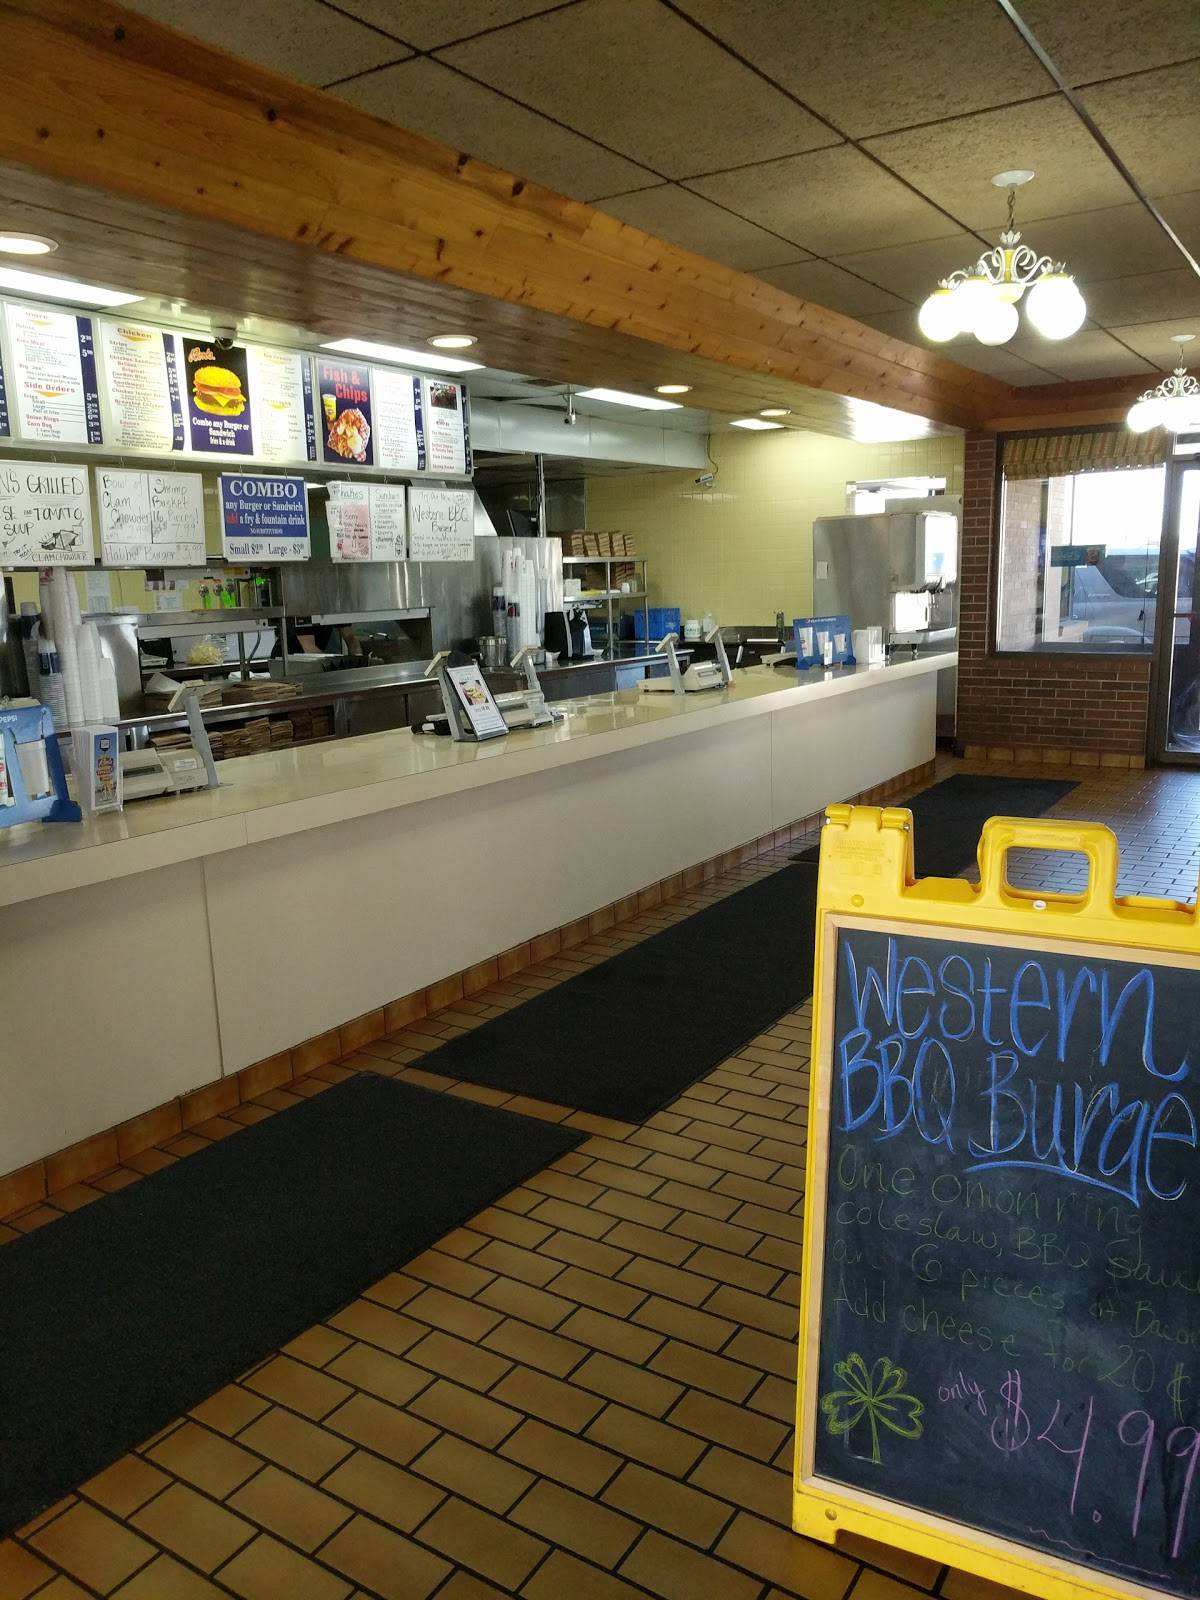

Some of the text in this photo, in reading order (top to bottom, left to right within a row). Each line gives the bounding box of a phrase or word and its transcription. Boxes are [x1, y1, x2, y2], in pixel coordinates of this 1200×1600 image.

[117, 328, 152, 339] Chicken
[322, 367, 361, 386] Fish &
[24, 381, 76, 393] Side Orders
[335, 384, 368, 404] Chips
[192, 416, 213, 426] Combo
[223, 420, 242, 431] Burger
[209, 427, 236, 438] Sandwich
[26, 473, 85, 496] GRILLED
[229, 480, 298, 499] COMBO
[33, 507, 83, 521] TOMATO
[225, 500, 304, 512] any Burger or Sandwich
[244, 513, 254, 526] fry
[261, 513, 288, 525] fountain
[288, 515, 305, 526] drink
[229, 543, 250, 555] Small
[268, 543, 288, 558] Large
[843, 936, 1192, 1082] Western
[838, 1027, 957, 1155] BBQ
[837, 1143, 916, 1195] One
[931, 1173, 1040, 1219] onion
[1013, 1227, 1092, 1269] BBQ
[911, 1242, 943, 1283] 6
[832, 1272, 886, 1324] Add
[902, 1296, 1021, 1358] cheese
[1097, 1344, 1157, 1394] 20
[938, 1371, 987, 1417] only
